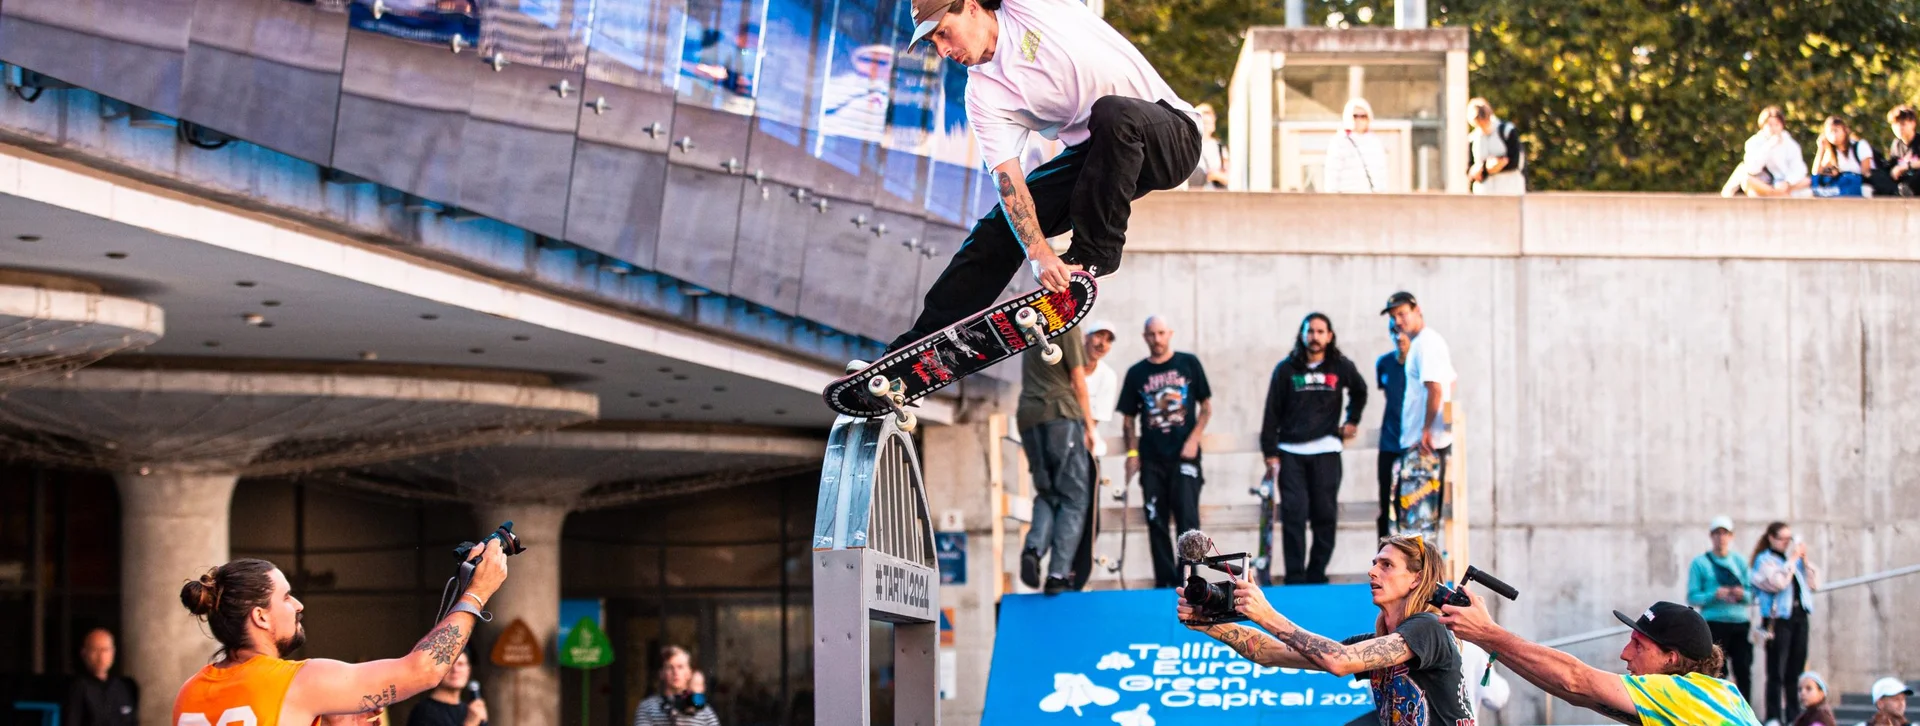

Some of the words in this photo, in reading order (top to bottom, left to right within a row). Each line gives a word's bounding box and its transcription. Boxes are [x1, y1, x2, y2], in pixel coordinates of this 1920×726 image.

[1029, 295, 1067, 332] THRASHER
[1128, 642, 1247, 660] Tallin
[1118, 675, 1247, 691] Green
[1160, 688, 1315, 710] Capital
[1320, 693, 1372, 705] 202
